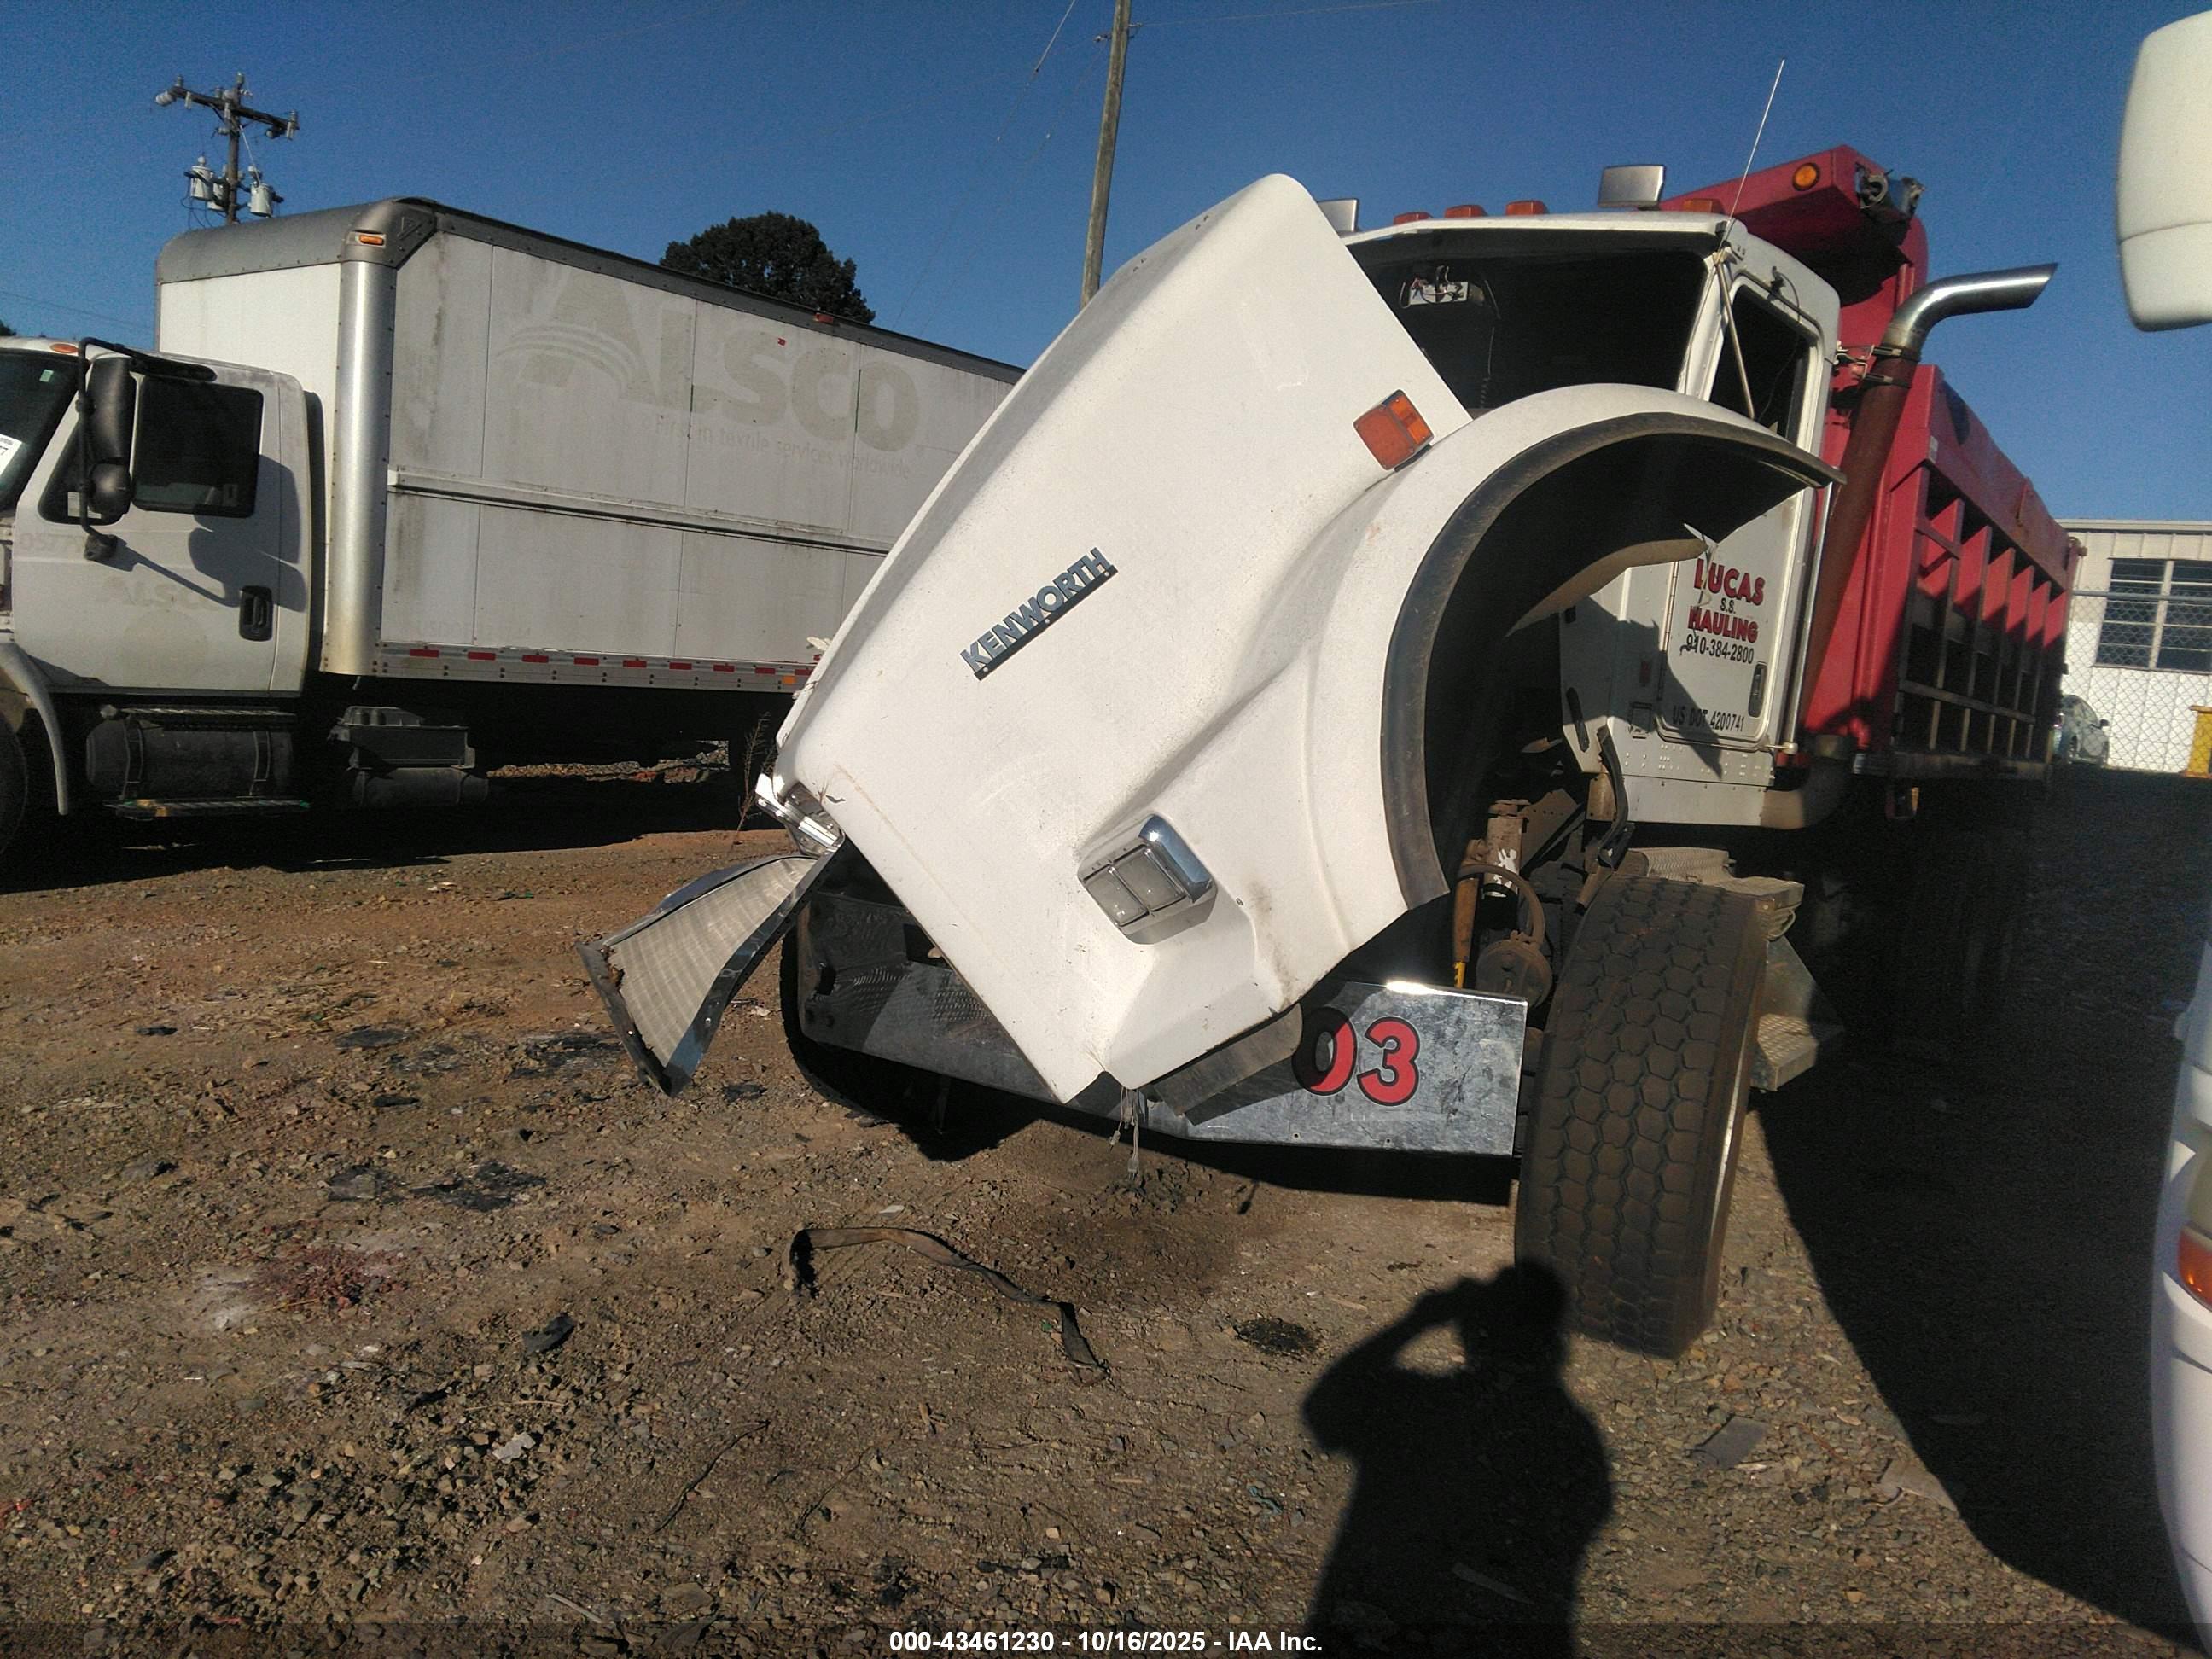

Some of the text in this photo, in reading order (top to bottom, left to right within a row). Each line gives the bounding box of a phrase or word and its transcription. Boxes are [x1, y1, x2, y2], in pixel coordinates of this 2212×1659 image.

[1694, 558, 1766, 606] LUCAS
[960, 547, 1113, 674] KENWORTH
[1720, 597, 1736, 614] S.S.
[1688, 606, 1759, 643] HAULING
[1686, 634, 1755, 665] 910-384-2800
[1673, 705, 1745, 733] US DOT 4200741
